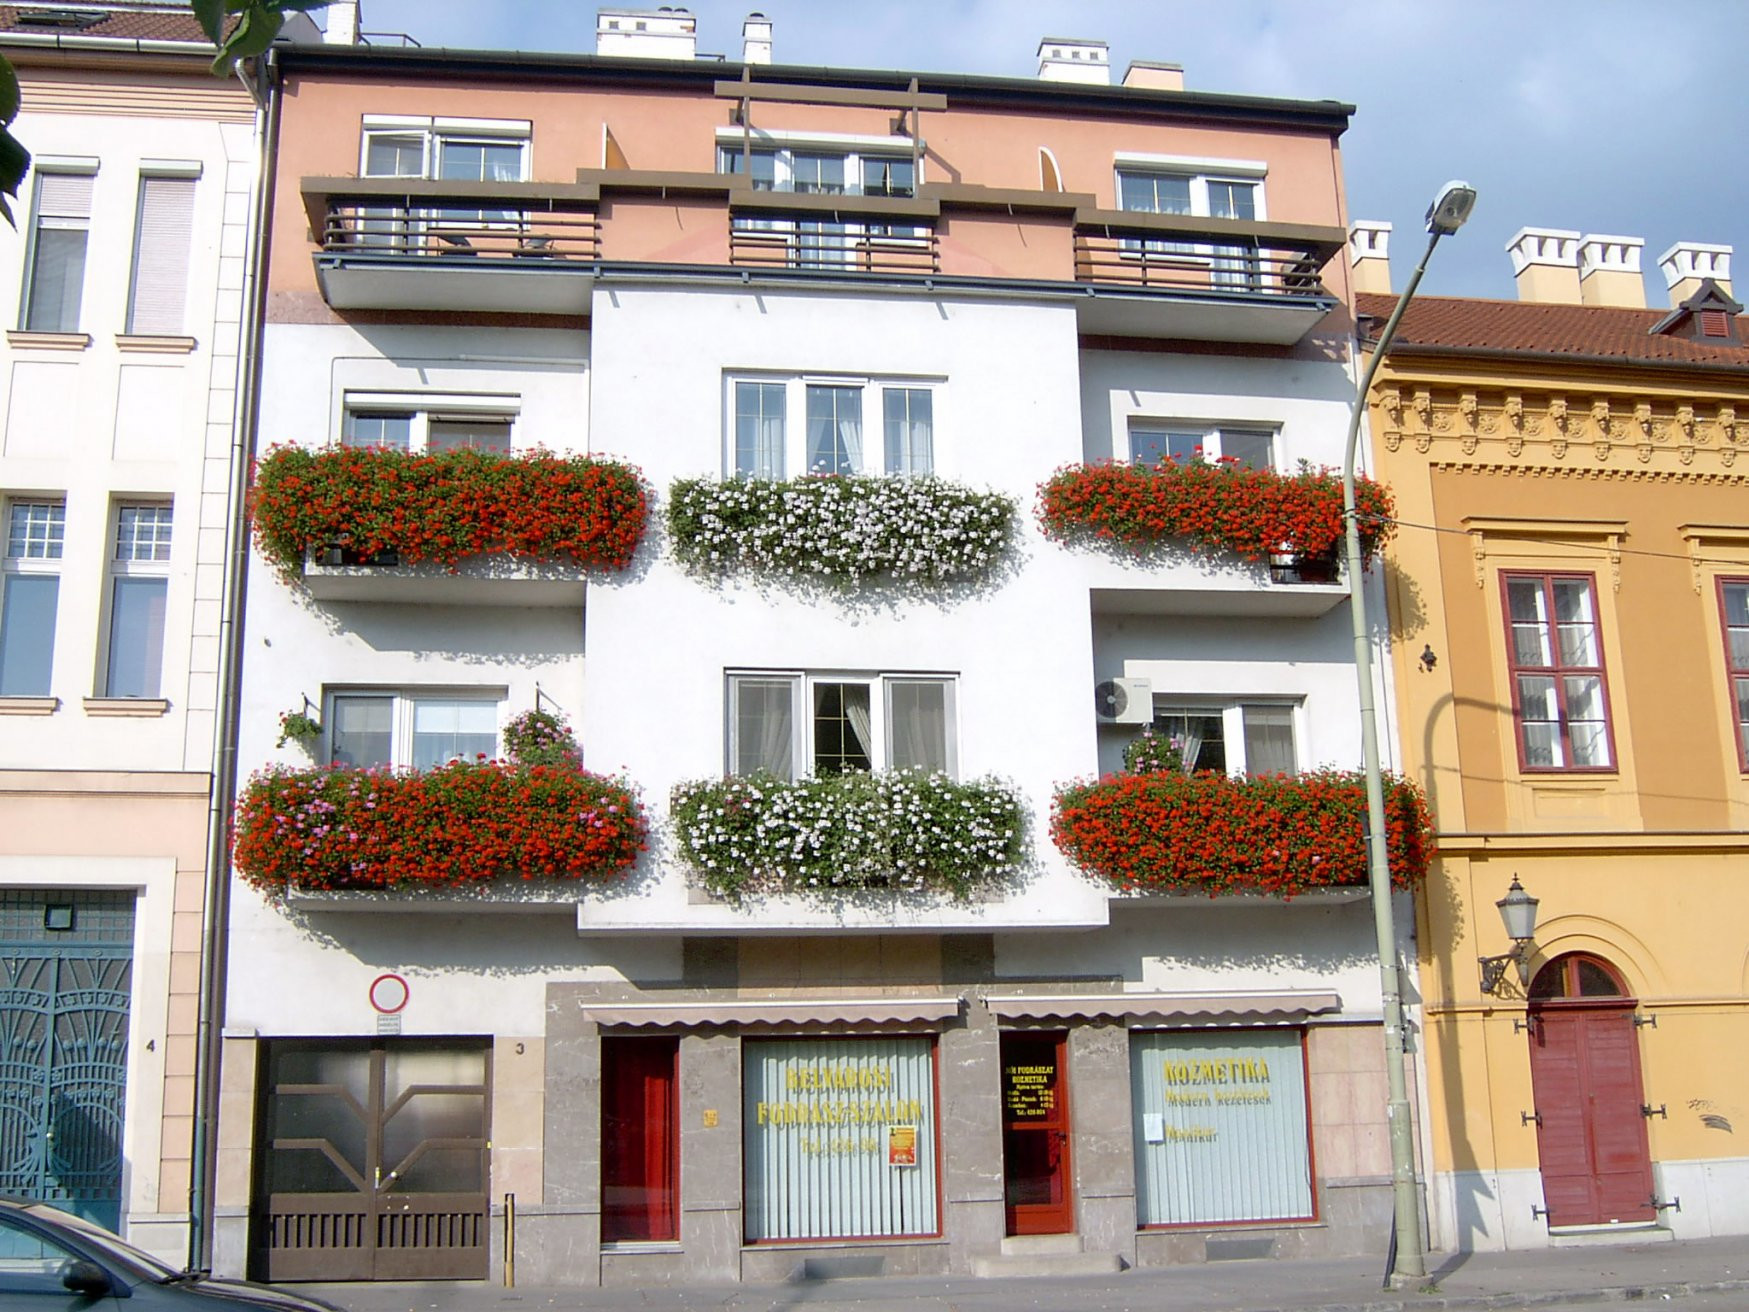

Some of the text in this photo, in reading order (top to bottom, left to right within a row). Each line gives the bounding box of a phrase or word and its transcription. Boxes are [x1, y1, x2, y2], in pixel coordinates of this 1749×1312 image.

[146, 1039, 155, 1052] 4
[516, 1042, 524, 1055] 3
[1164, 1057, 1269, 1083] KOZMETIKA
